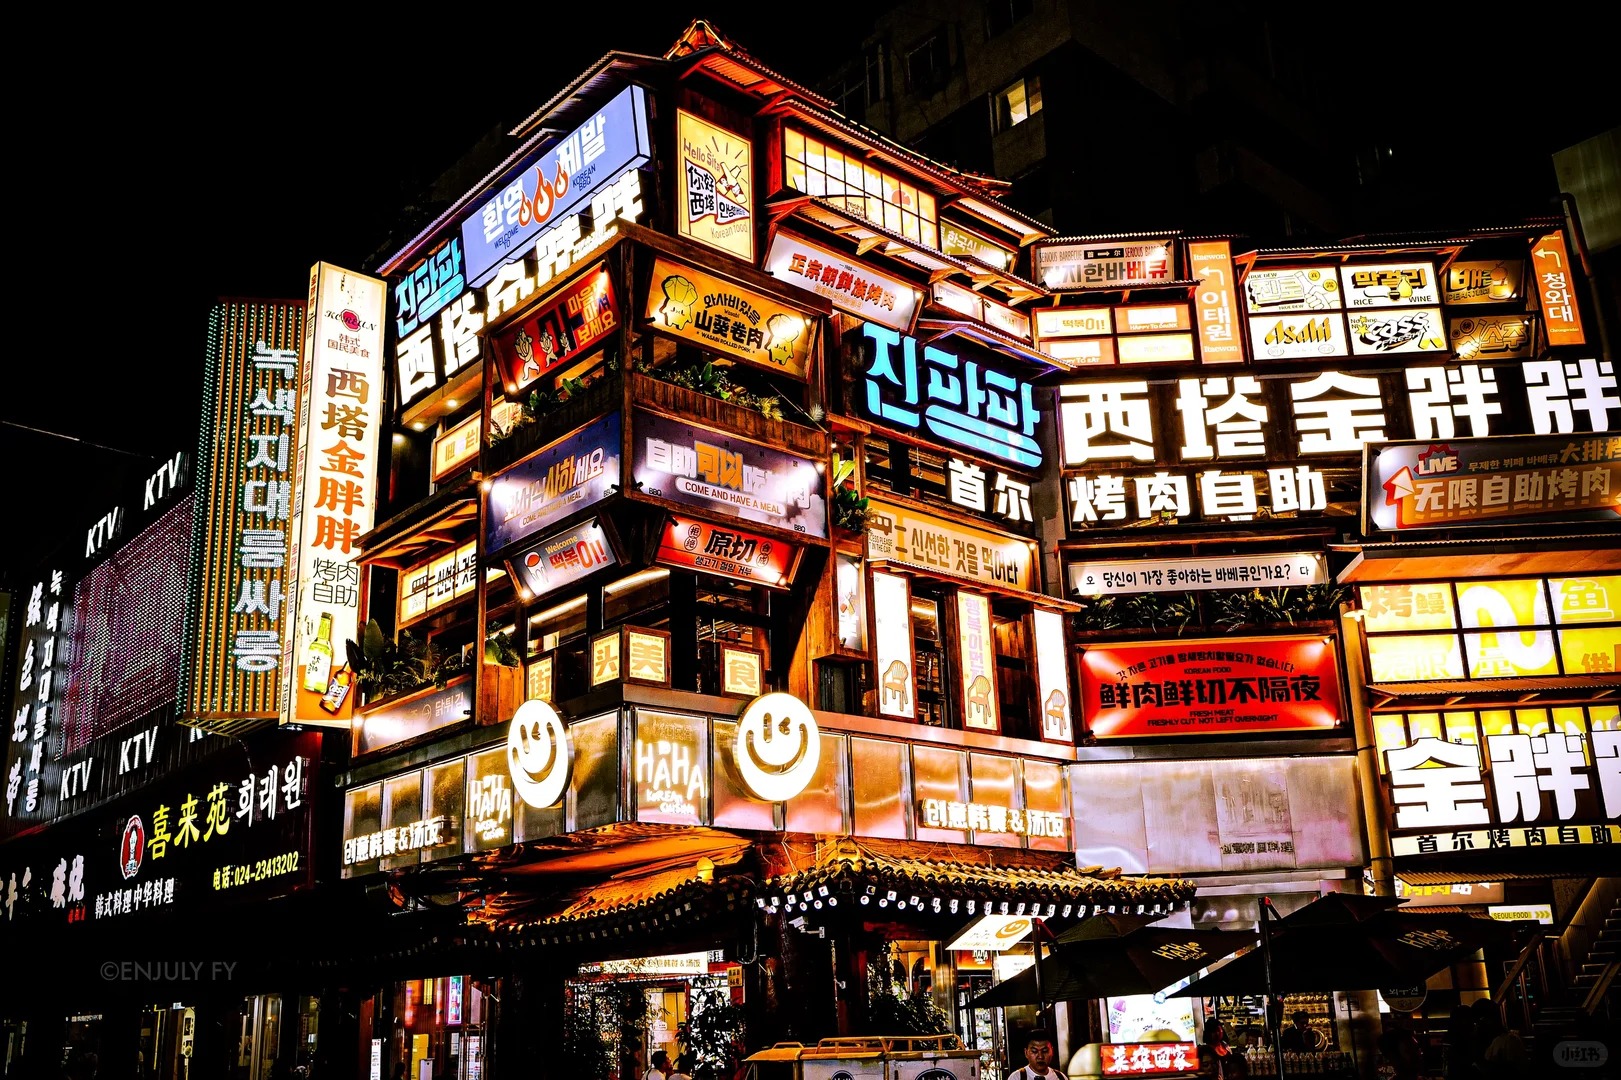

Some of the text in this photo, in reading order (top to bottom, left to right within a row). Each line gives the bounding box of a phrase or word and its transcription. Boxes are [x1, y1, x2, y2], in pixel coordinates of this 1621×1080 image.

[683, 137, 706, 163] Hello
[572, 163, 596, 189] KOREAN
[578, 179, 592, 192] BBQ
[687, 165, 715, 194] 你好
[690, 191, 715, 217] 西塔
[494, 225, 519, 249] WELCOME
[503, 239, 512, 251] TO
[711, 226, 734, 240] Korean
[947, 230, 978, 253] 한국식
[1125, 246, 1143, 258] SERIOUS
[1193, 253, 1227, 261] Itaewon
[1353, 295, 1432, 306] RICE WINE
[1542, 272, 1574, 322] 청와대
[577, 310, 617, 346] 보세요
[1129, 323, 1149, 331] HAPPY
[1201, 290, 1233, 341] 이태원
[338, 332, 361, 348] 韩式
[694, 309, 764, 349] 山葵卷肉
[701, 331, 721, 343] WASABI
[720, 338, 738, 349] ROLLED
[1264, 316, 1332, 346] Asahi
[1480, 320, 1529, 352] 소주
[327, 338, 371, 359] 国民美食
[1204, 345, 1238, 353] Itaewon
[1059, 359, 1621, 466] 西塔金胖胖
[311, 367, 370, 555] 西塔金胖胖
[1418, 455, 1458, 475] LIVE
[144, 451, 182, 511] KTV
[648, 487, 662, 497] BBQ
[949, 456, 1034, 523] 首尔
[1070, 465, 1328, 523] 烤肉自助
[1414, 466, 1611, 512] 无限自助烤肉
[567, 493, 582, 504] MEAL
[685, 481, 781, 515] COME AND HAVE A MEAL
[86, 506, 119, 558] KTV
[794, 524, 806, 533] BBQ
[545, 534, 578, 555] Welcome
[704, 529, 758, 563] 原切
[911, 527, 1019, 585] 신선한 것을 먹어라
[312, 557, 359, 588] 烤肉
[1085, 564, 1309, 588] 오 당신이 가장 좋아하는 바베큐인가요? 다
[313, 584, 358, 608] 自助
[529, 641, 758, 700] 街 头 美 食
[1148, 654, 1176, 669] 고기를
[1255, 655, 1295, 673] 없습니다
[1183, 666, 1232, 675] KOREAN FOOD
[1100, 675, 1322, 710] 鲜肉鲜切不隔夜
[1147, 714, 1279, 727] FRESHLY CUT NOT LEFT OVERNIGHT
[1189, 709, 1235, 718] FRESH MEAT
[119, 725, 158, 775] KTV
[60, 757, 93, 801] KTV
[637, 739, 706, 800] HAHA
[236, 756, 303, 828] 희래원
[468, 774, 512, 823] HAHA
[147, 782, 231, 861] 喜来苑
[1417, 825, 1612, 854] 首尔烤肉自助
[1493, 911, 1529, 920] SEOUL FOOD
